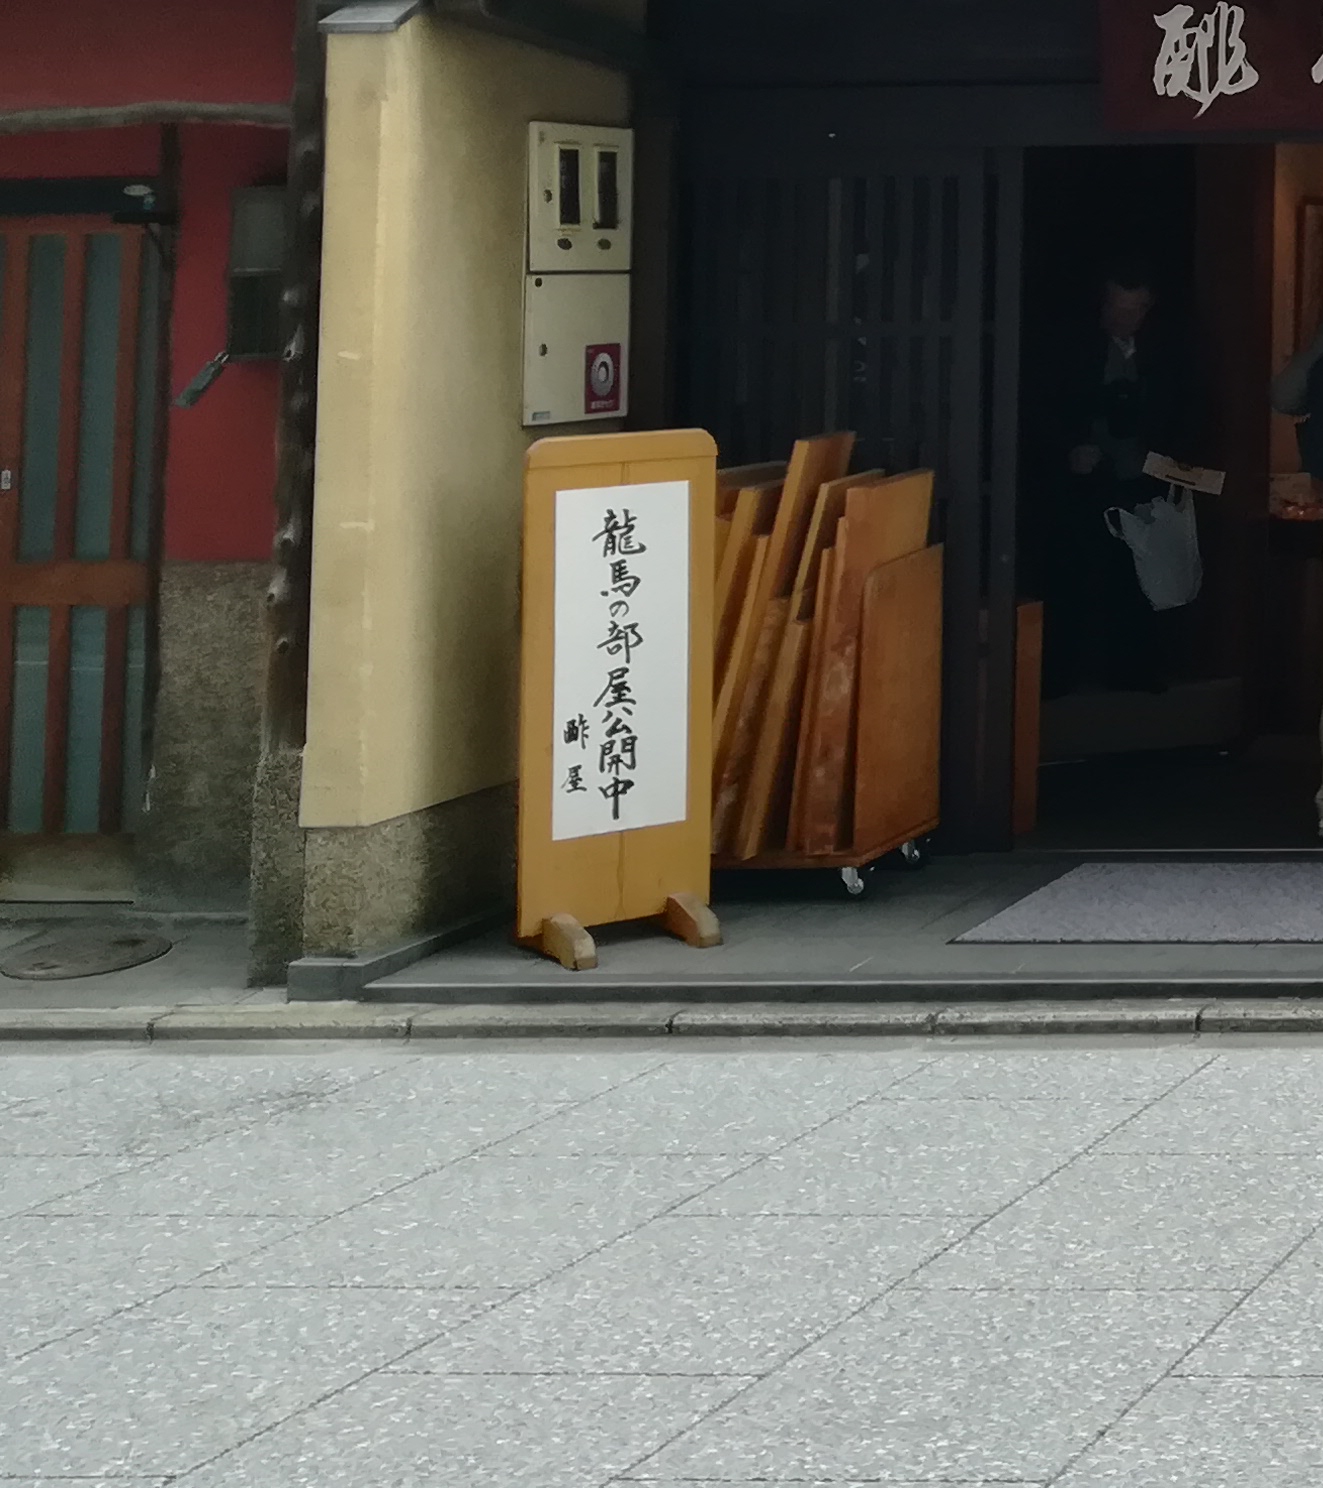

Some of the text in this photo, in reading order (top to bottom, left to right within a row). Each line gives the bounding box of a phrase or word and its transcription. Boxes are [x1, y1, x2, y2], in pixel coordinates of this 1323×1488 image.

[562, 713, 589, 794] 酢屋
[591, 508, 647, 820] 龍馬の部屋公開中
